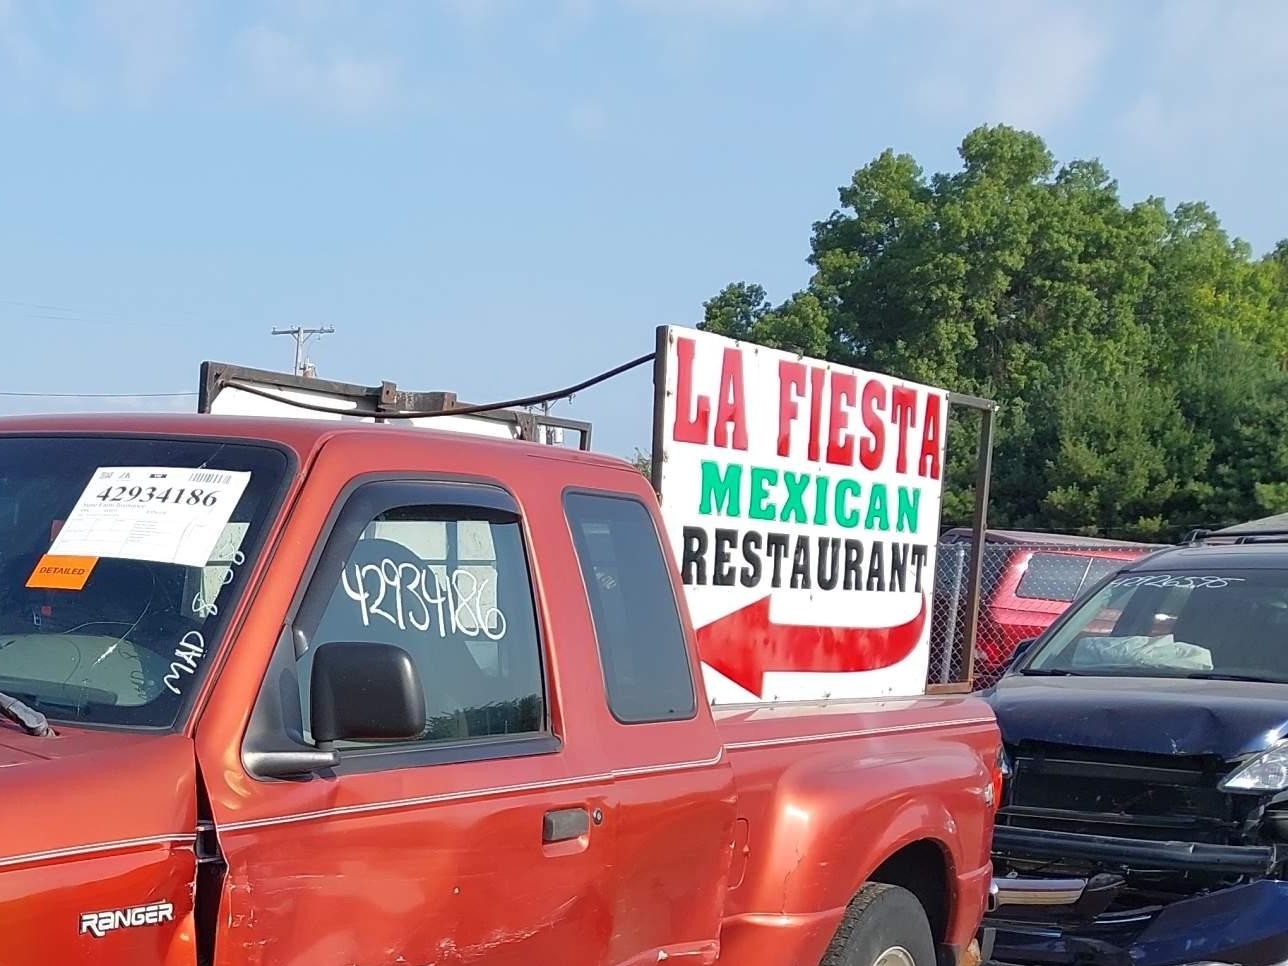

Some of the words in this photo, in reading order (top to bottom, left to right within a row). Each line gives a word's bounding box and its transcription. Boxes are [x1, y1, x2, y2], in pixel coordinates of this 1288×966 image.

[673, 336, 748, 451] LA
[777, 360, 942, 481] FIESTA
[97, 485, 224, 507] 42934186
[698, 458, 922, 534] MEXICAN
[39, 566, 86, 576] DETAILED
[680, 525, 929, 593] RESTAURANT
[341, 558, 507, 641] 42934186
[163, 630, 205, 695] MAD
[79, 902, 174, 937] RANGER
